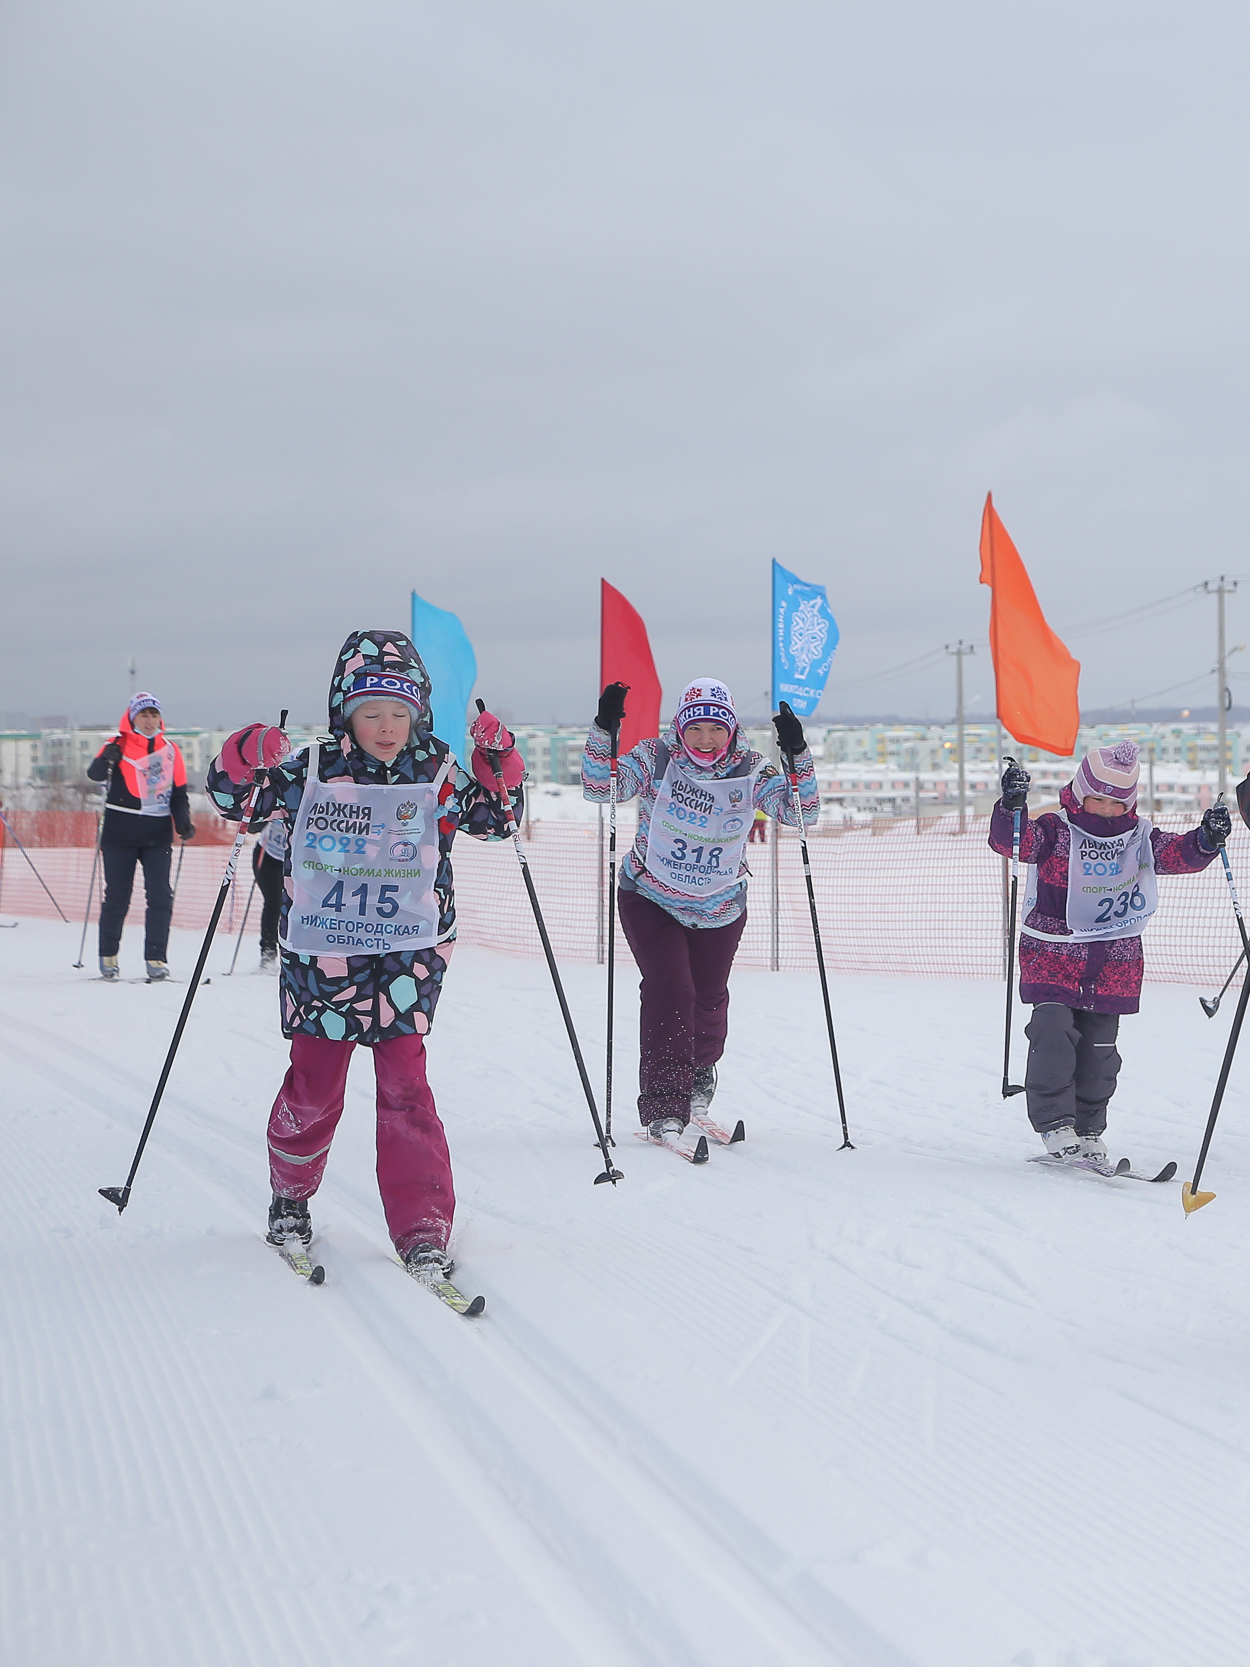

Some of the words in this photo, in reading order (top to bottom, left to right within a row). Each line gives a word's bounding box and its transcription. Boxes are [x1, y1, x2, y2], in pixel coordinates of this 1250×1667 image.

[671, 789, 713, 815] РОССИИ
[672, 780, 715, 803] ЛЫЖНЯ
[309, 801, 372, 821] ЛЫЖНЯ
[666, 802, 708, 828] 2022
[306, 816, 371, 836] РОССИИ
[304, 831, 367, 855] 2022
[671, 838, 723, 869] 318
[1079, 838, 1125, 850] ЛЫЖНЯ
[302, 860, 335, 874] СПОРТ
[343, 866, 382, 879] НОРМА
[383, 867, 421, 879] ЖИЗНИ
[321, 880, 400, 919] 415
[1082, 886, 1108, 894] СПОРТ
[301, 915, 420, 936] НИЖЕГОРОДСКАЯ
[326, 934, 392, 950] ОБЛАСТЬ
